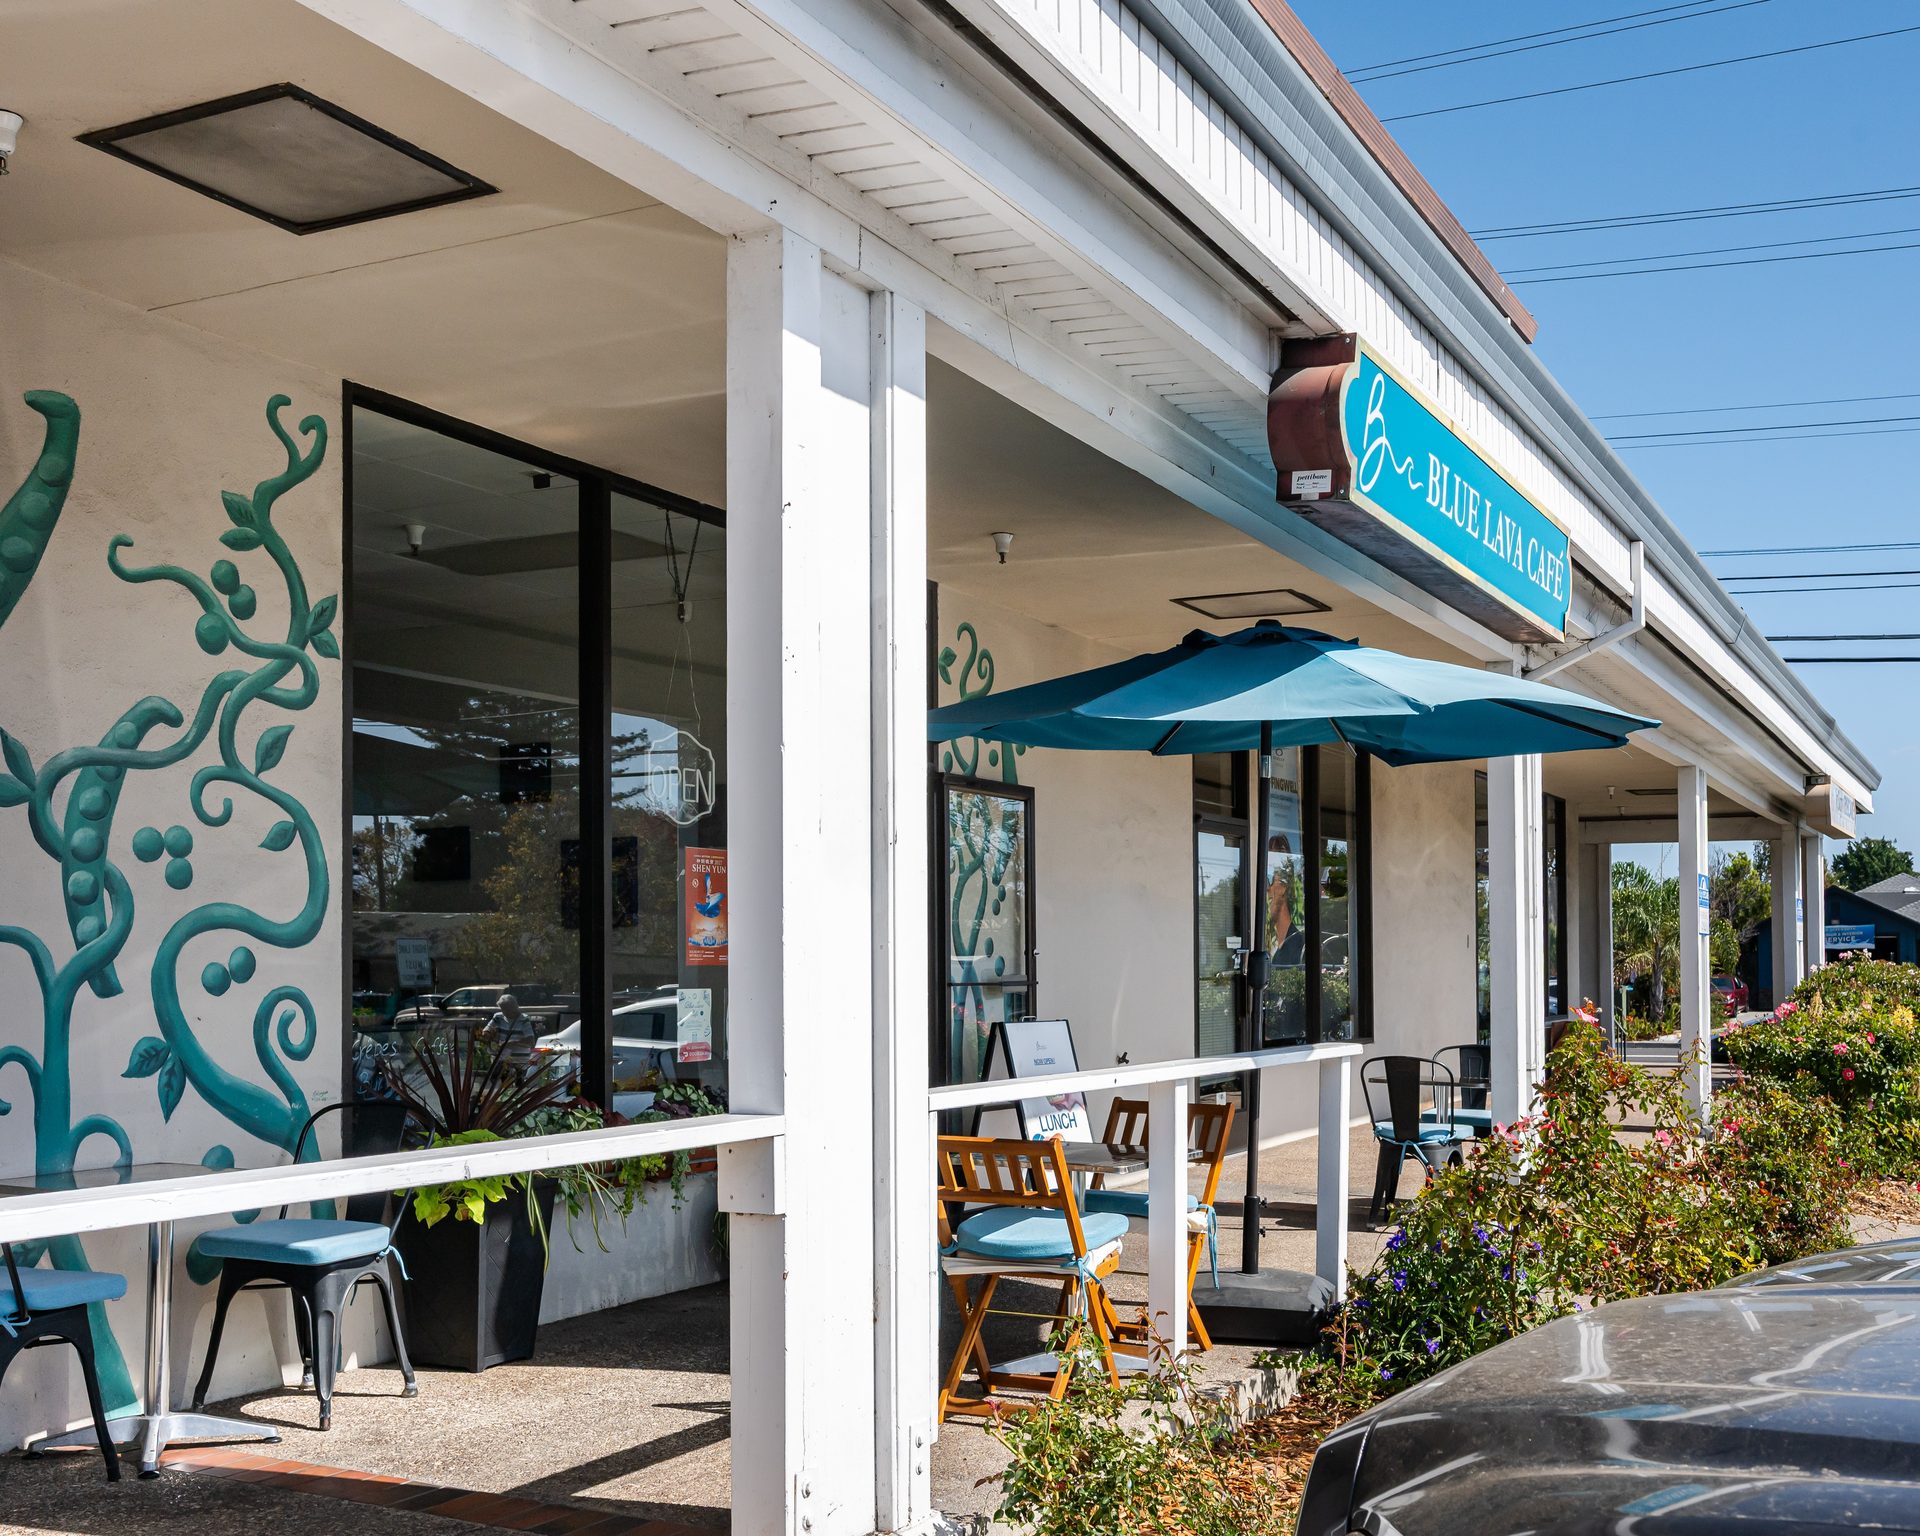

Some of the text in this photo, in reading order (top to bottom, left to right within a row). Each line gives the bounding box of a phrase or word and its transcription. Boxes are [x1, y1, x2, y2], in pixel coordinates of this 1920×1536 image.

[1426, 452, 1564, 601] BLUE LAVA CAFÉ
[651, 765, 713, 805] OPEN
[692, 864, 711, 873] SHEN
[1039, 1111, 1078, 1132] LUNCH
